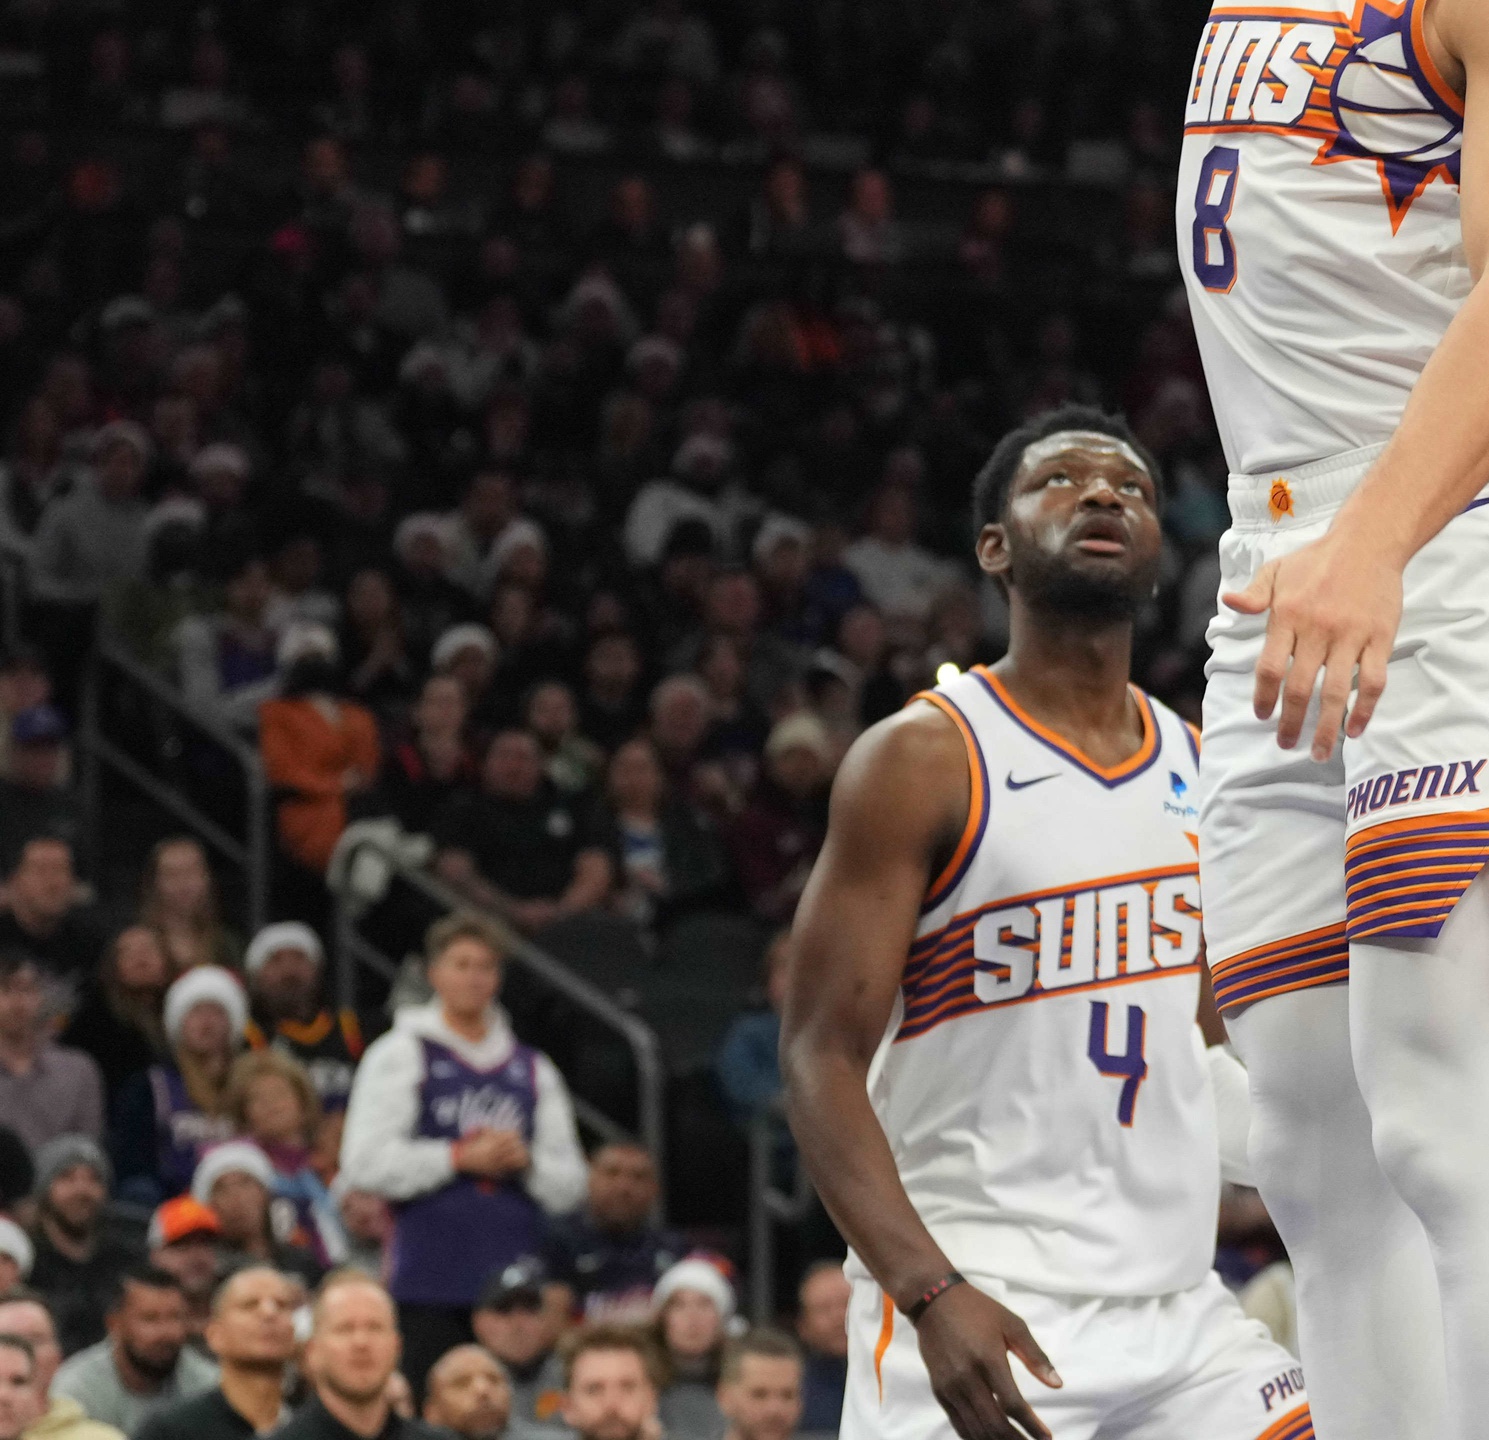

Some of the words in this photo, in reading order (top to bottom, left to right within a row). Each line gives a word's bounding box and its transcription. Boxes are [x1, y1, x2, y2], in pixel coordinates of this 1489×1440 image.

[1184, 20, 1337, 126] UNS
[1192, 146, 1240, 295] 8
[1347, 758, 1489, 820] PHOENIX
[973, 875, 1201, 1005] SUNS
[1087, 1000, 1148, 1129] 4
